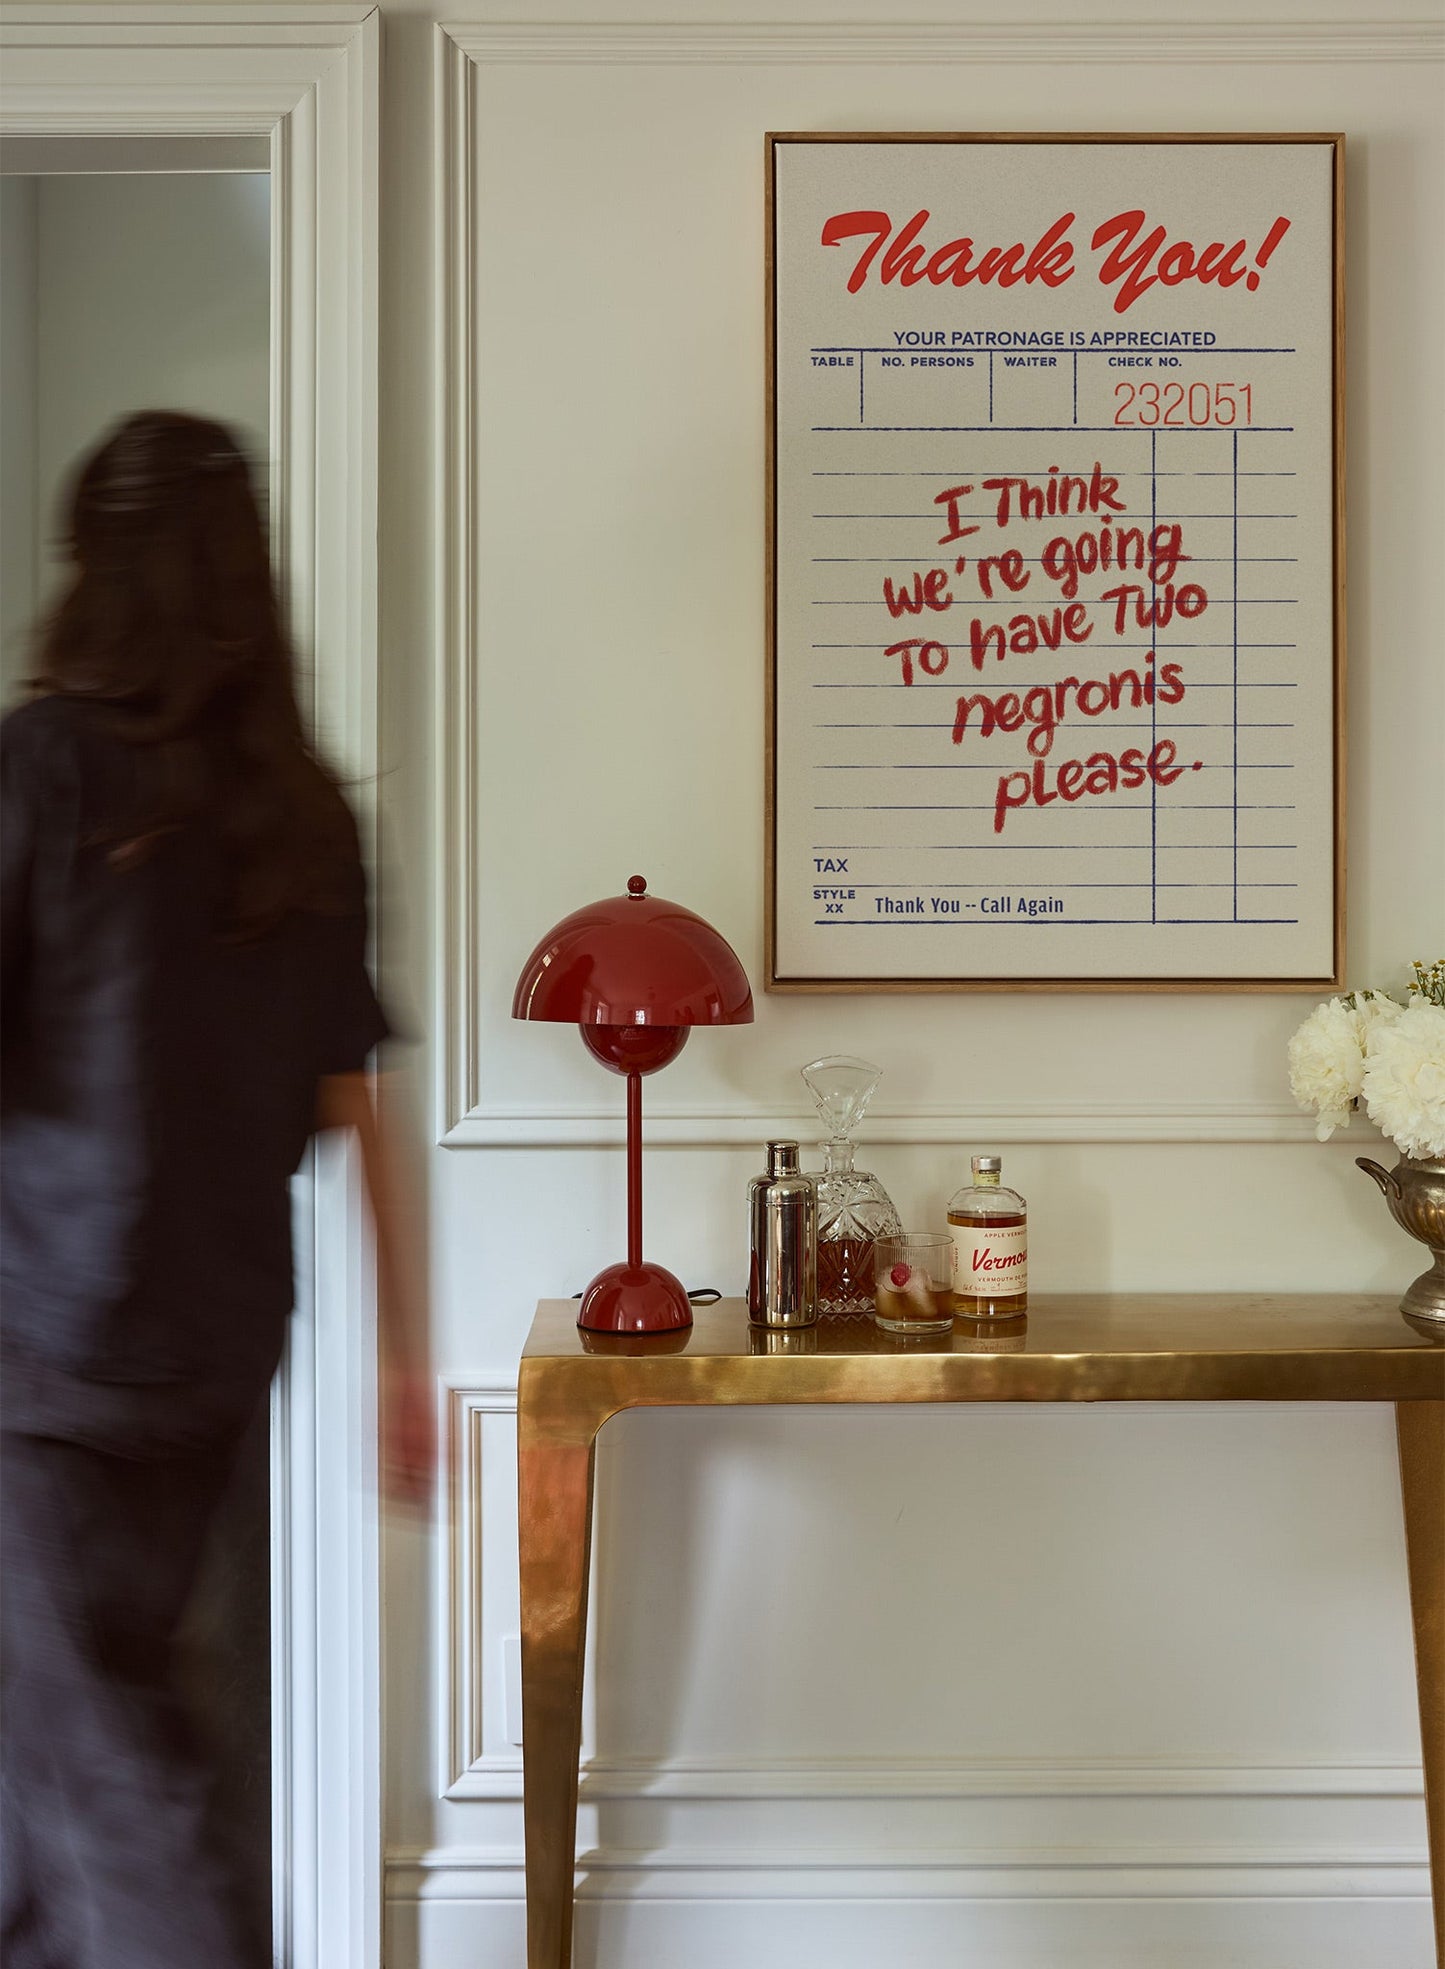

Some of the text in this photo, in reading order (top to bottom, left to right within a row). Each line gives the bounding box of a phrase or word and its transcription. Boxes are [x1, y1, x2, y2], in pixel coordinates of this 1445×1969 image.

[821, 209, 1291, 314] Thank You!
[894, 331, 1217, 346] YOUR PATRONAGE IS APPRECIATED
[810, 356, 854, 367] TABLE
[881, 356, 975, 367] NO. PERSONS
[1003, 356, 1057, 367] WAITER
[1108, 356, 1183, 367] CHECK NO.
[1113, 382, 1252, 426] 232051
[934, 462, 1126, 545] I Think
[1041, 514, 1193, 600] going
[969, 603, 1094, 671] have
[951, 651, 1185, 758] negronis
[993, 739, 1203, 834] please.
[813, 858, 849, 873] TAX
[813, 889, 856, 900] STYLE
[825, 903, 844, 914] XX
[875, 896, 925, 914] Thank
[930, 896, 960, 914] You
[980, 896, 1011, 914] Call
[1017, 896, 1064, 917] Again
[978, 1275, 1014, 1283] VERMOUTH
